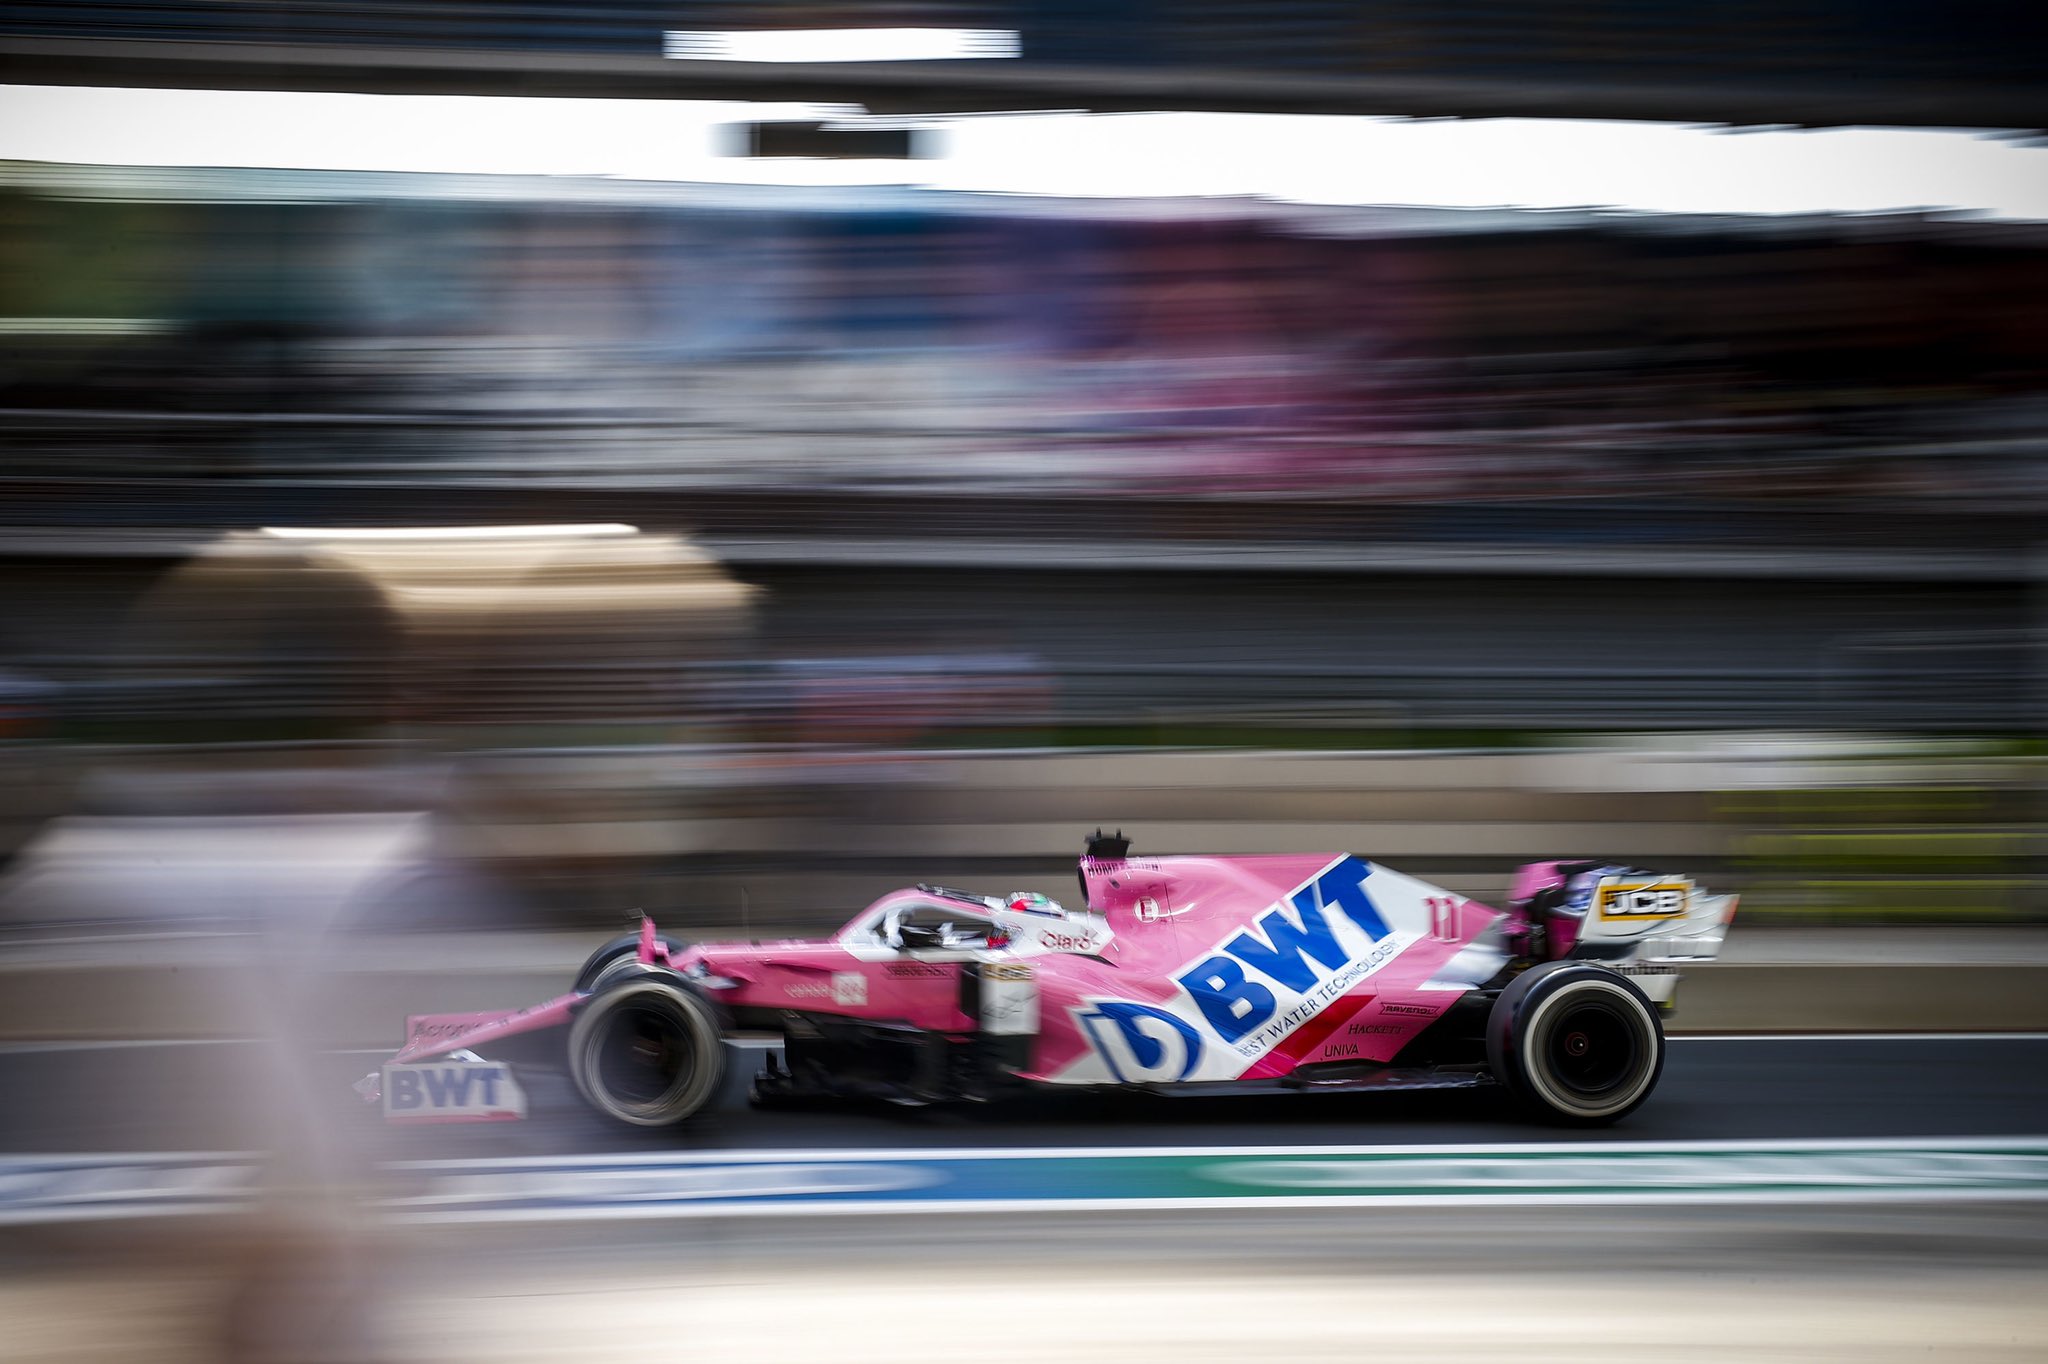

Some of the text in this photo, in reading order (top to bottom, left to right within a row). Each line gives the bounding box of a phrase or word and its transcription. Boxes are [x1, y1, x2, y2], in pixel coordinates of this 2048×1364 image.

[1424, 896, 1462, 943] 11
[1605, 890, 1683, 915] JCB
[1039, 929, 1095, 951] Claro
[1178, 855, 1396, 1045] BWT
[1235, 939, 1403, 1059] BEST WATER TECHNOLOGY
[1324, 1043, 1360, 1058] UNIVA
[391, 1066, 503, 1111] BWT
